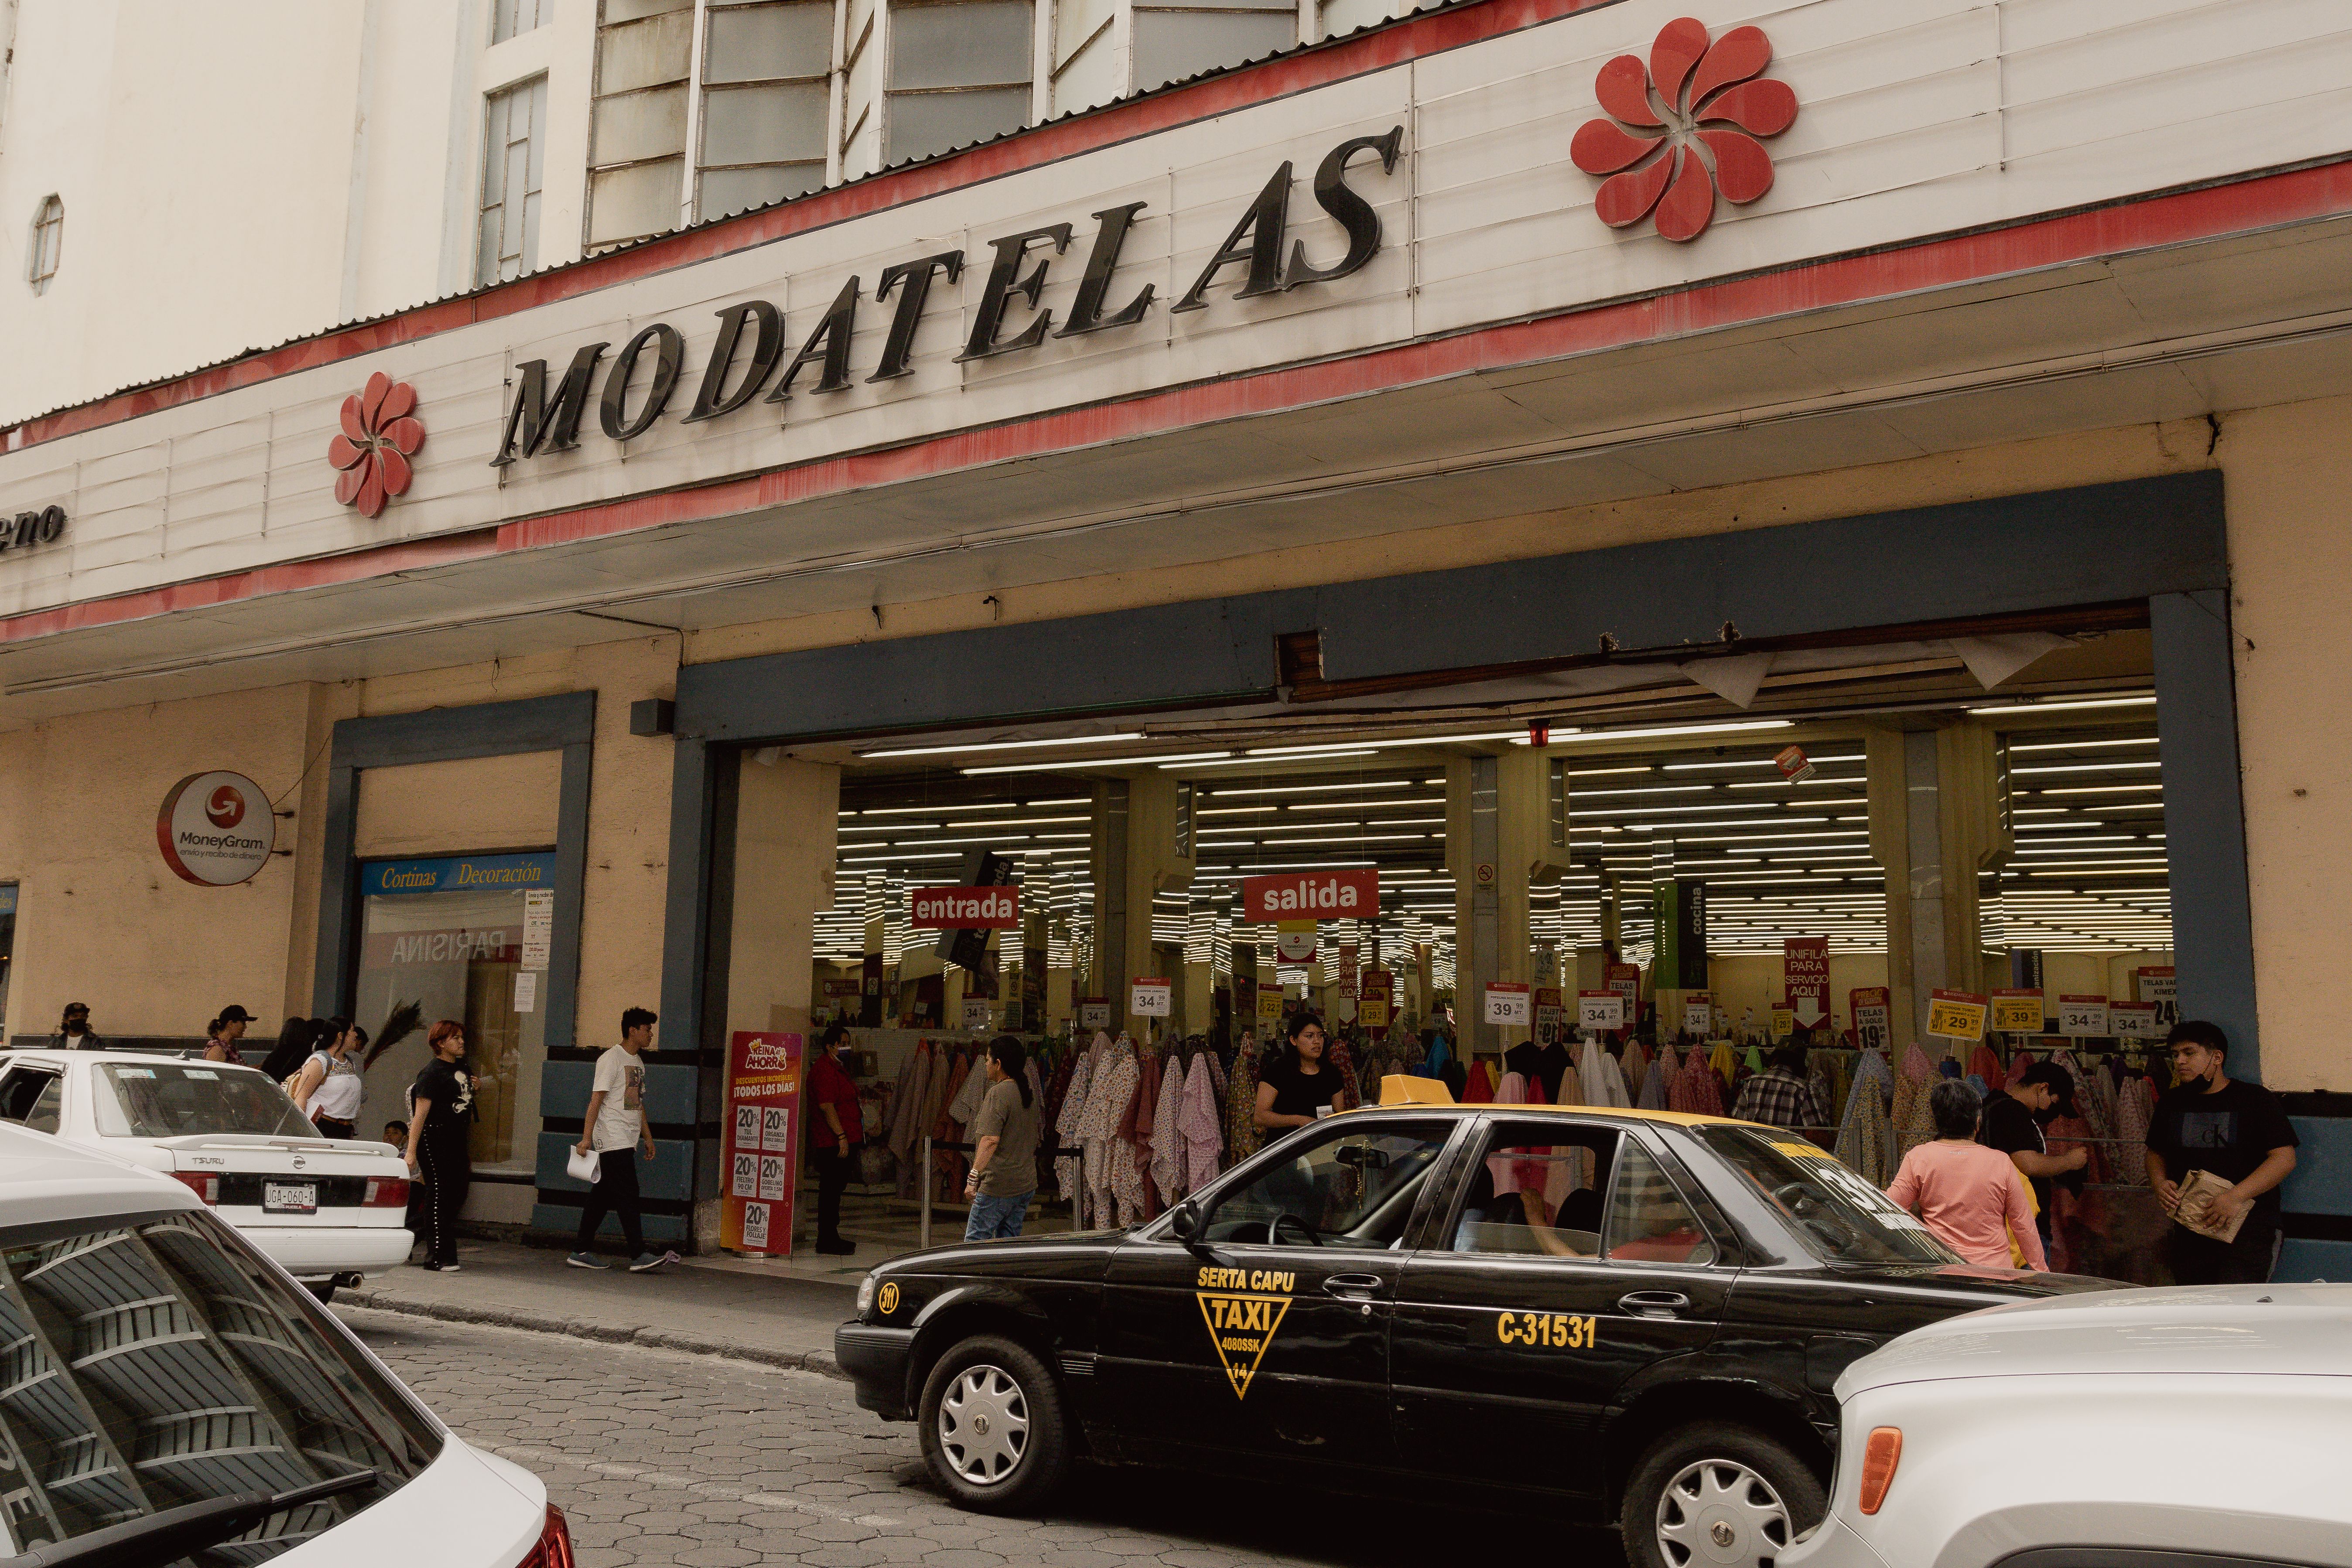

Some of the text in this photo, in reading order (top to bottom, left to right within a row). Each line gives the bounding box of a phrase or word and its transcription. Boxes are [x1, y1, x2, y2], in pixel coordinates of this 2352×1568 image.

[489, 125, 1404, 468] MODATELAS
[180, 831, 263, 849] MoneyGram
[382, 861, 541, 888] Cortinas Decoración
[1264, 878, 1357, 911] salida
[916, 892, 1012, 919] entrada
[1690, 887, 1702, 935] cocina
[1785, 949, 1828, 959] UNIFILA
[1610, 965, 1634, 974] PRECIO
[1791, 961, 1823, 971] PARA
[1785, 975, 1829, 984] SERVICIO
[1139, 996, 1155, 1007] 34
[967, 1008, 978, 1018] 34
[1494, 1003, 1511, 1015] 39
[1588, 1009, 1606, 1021] 34
[1087, 1012, 1098, 1021] 34
[1691, 1015, 1700, 1025] 34
[1949, 1016, 1967, 1028] 29
[2011, 1012, 2028, 1022] 39
[2068, 1014, 2089, 1026] 34
[2119, 1019, 2137, 1030] 34
[1859, 1025, 1880, 1049] 19
[752, 1045, 775, 1056] REINA
[735, 1076, 766, 1085] DESCUENTOS
[734, 1081, 794, 1098] ¡TODOS LOS DÍAS!
[738, 1108, 760, 1127] 20%
[765, 1110, 786, 1130] 20%
[735, 1156, 757, 1175] 20%
[762, 1158, 783, 1179] 20%
[266, 1189, 314, 1203] UGA-060-A
[746, 1205, 768, 1225] 20%
[746, 1231, 766, 1239] FOLLAJE
[1198, 1267, 1295, 1292] SERTA CAPU
[882, 1288, 895, 1308] 311
[1211, 1300, 1270, 1331] TAXI
[1498, 1312, 1596, 1348] C-31531
